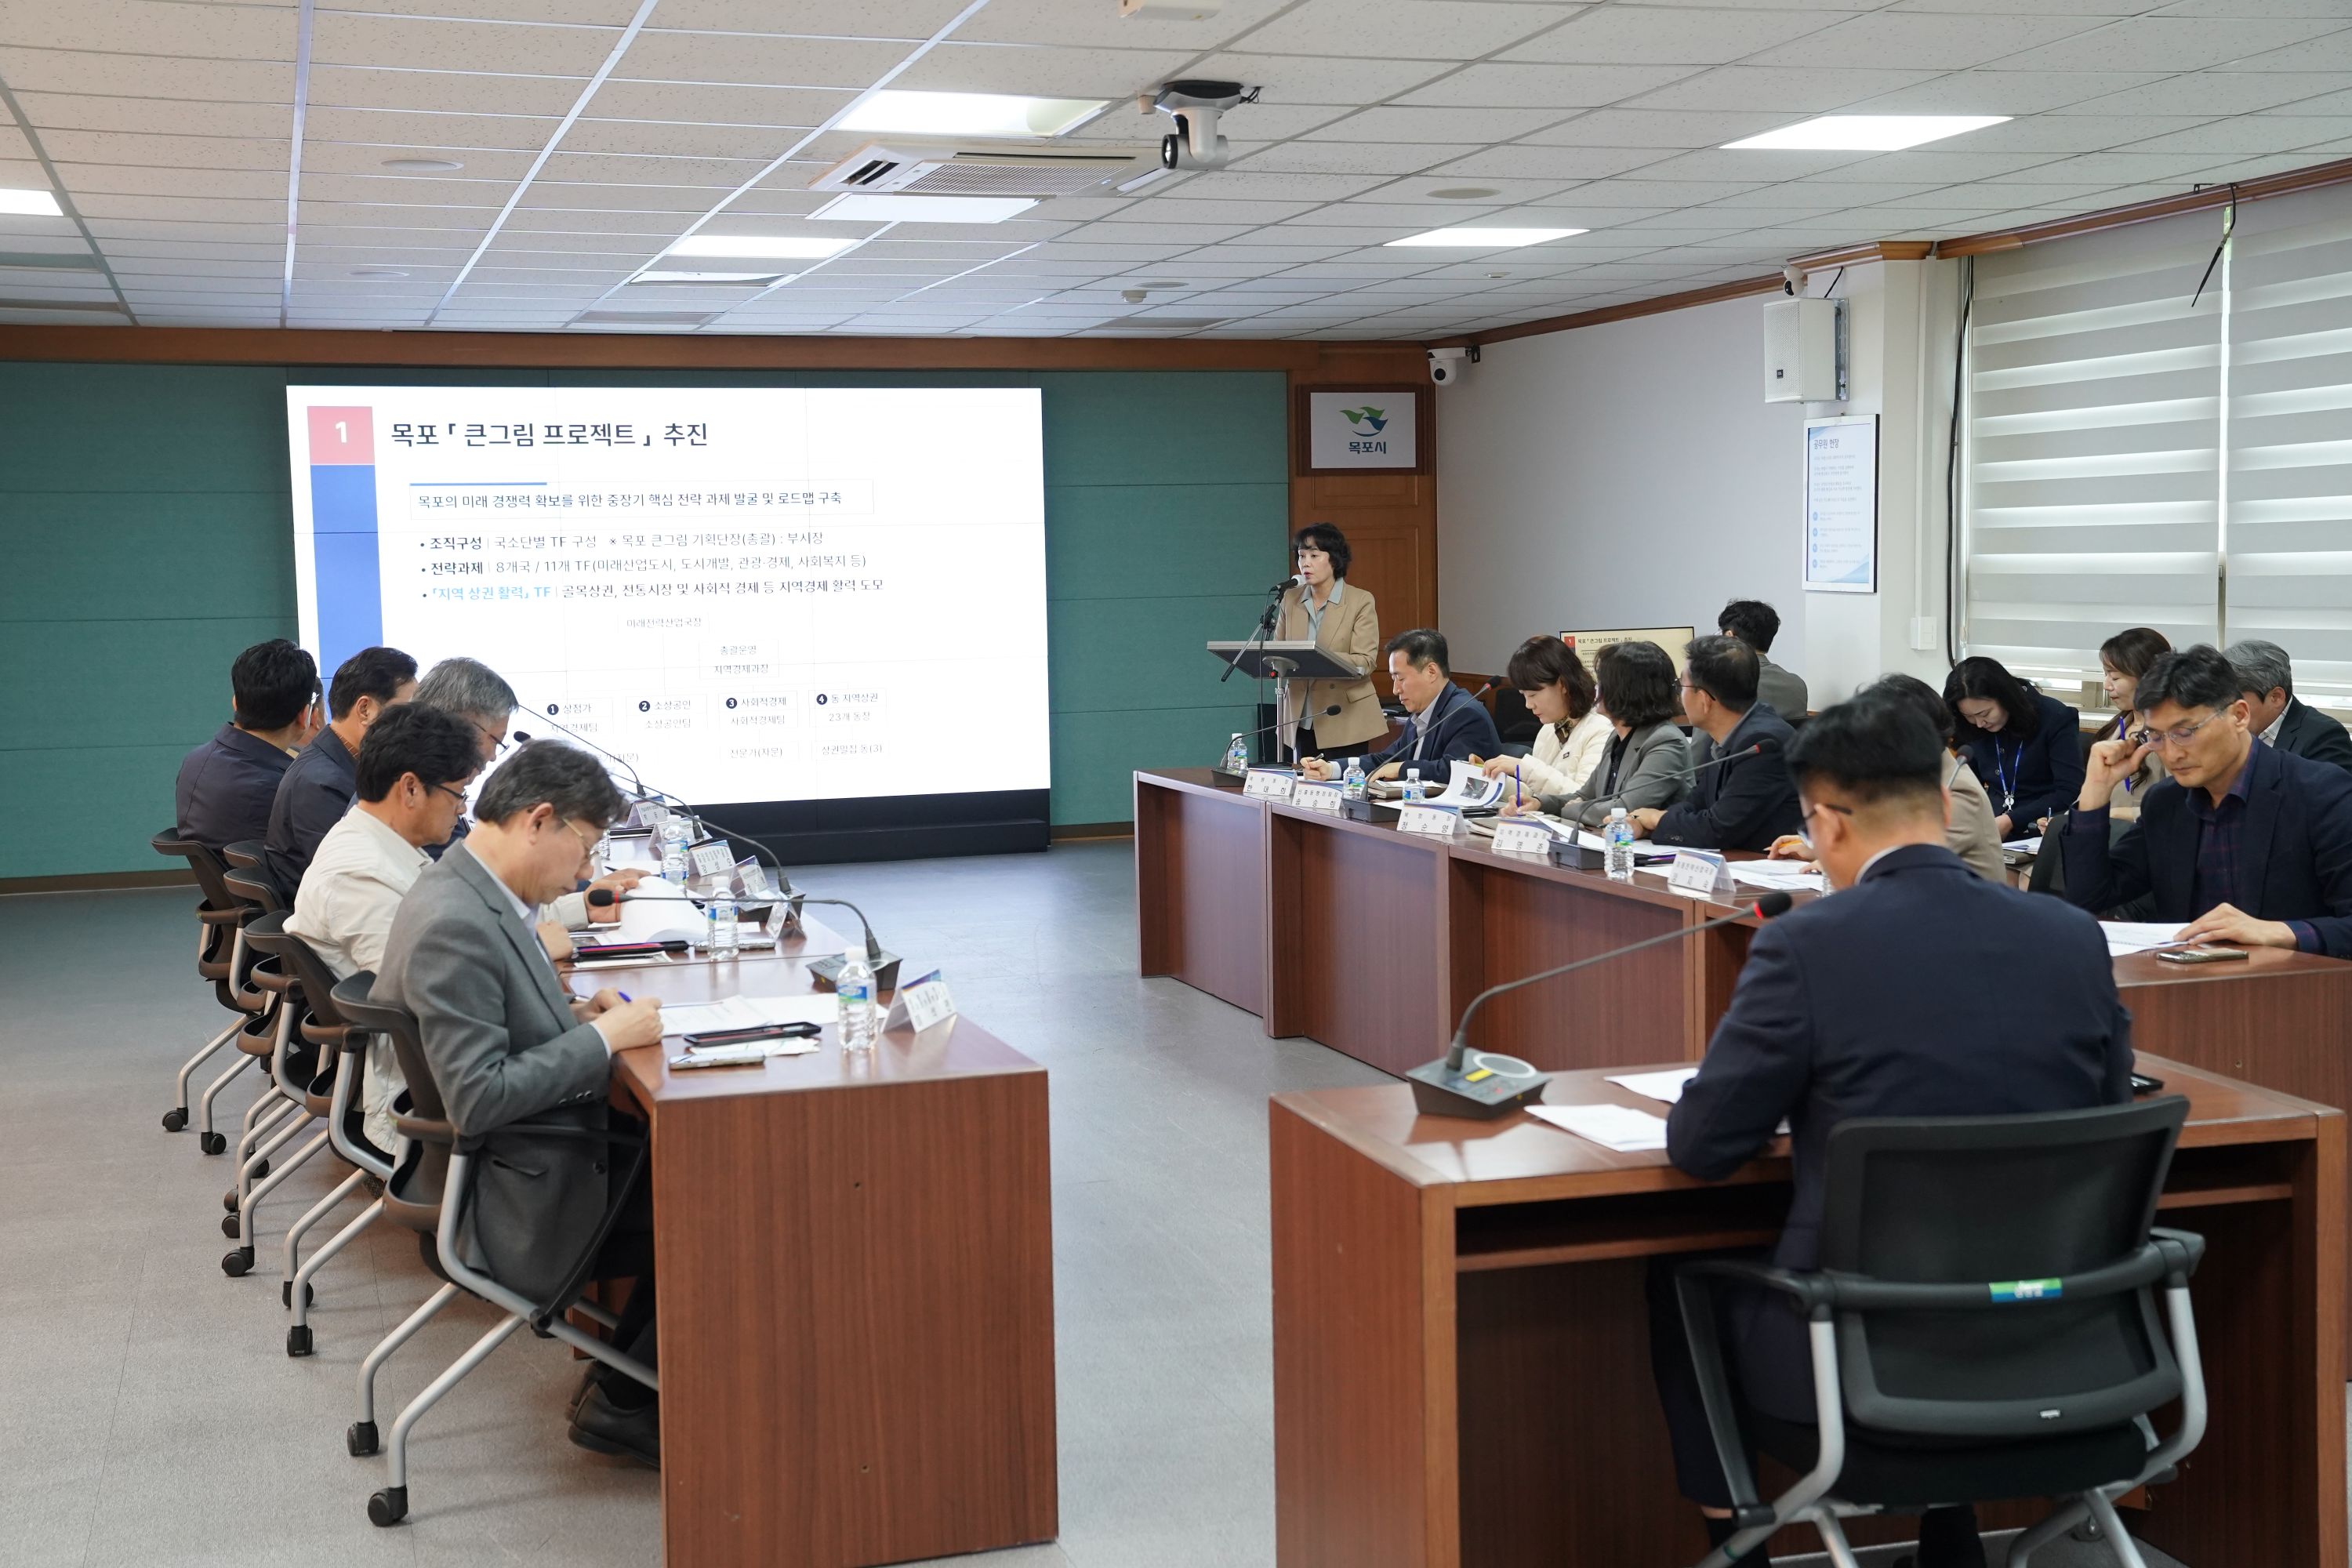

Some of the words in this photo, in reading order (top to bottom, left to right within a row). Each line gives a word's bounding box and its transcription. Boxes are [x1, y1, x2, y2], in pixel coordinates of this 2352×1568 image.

[335, 421, 347, 443] 1
[391, 423, 439, 448] 목포
[664, 423, 708, 447] 추진
[1348, 441, 1387, 454] 목포시
[418, 495, 457, 508] 목포의
[463, 495, 488, 508] 미래
[492, 495, 531, 508] 경쟁력
[535, 494, 573, 507] 확보를
[579, 494, 602, 507] 위한
[607, 494, 644, 507] 중장기
[649, 493, 673, 506] 핵심
[677, 493, 702, 506] 전략
[706, 493, 730, 506] 과제
[735, 492, 758, 505] 발굴
[763, 492, 774, 506] 및
[779, 492, 814, 505] 로드맵
[818, 492, 841, 505] 구축
[430, 536, 482, 550] 조직구성
[495, 536, 545, 549] 국소단별
[550, 537, 567, 548] TF
[572, 535, 596, 548] 구성
[622, 534, 646, 547] 목포
[652, 533, 688, 546] 큰그림
[693, 532, 775, 546] 기획단장(총괄)
[788, 532, 823, 545] 부시장
[431, 561, 483, 575] 전략과제
[496, 561, 530, 574] 8개국
[546, 561, 570, 573] 11개
[681, 556, 733, 571] 도시개발,
[798, 555, 845, 568] 사회복지
[851, 554, 866, 568] 등)
[469, 587, 494, 601] 상권
[498, 586, 528, 601] 활력」
[534, 587, 551, 597] TF
[562, 585, 617, 599] 골목상권,
[622, 583, 671, 597] 전통시장
[677, 583, 688, 596] 및
[694, 582, 730, 596] 사회적
[735, 582, 758, 594] 경제
[764, 581, 775, 594] 등
[779, 580, 827, 593] 지역경제
[832, 579, 855, 593] 활력
[861, 579, 883, 591] 도모
[627, 617, 701, 628] 미래전략산업국장
[720, 645, 757, 656] 총괄운영
[714, 664, 768, 675] 지역경제과장
[742, 697, 786, 707] 사회적경제
[831, 693, 840, 703] 동
[843, 692, 878, 703] 지역상권
[562, 703, 591, 714] 상점가
[654, 700, 691, 710] 소상공인
[829, 712, 850, 722] 23개
